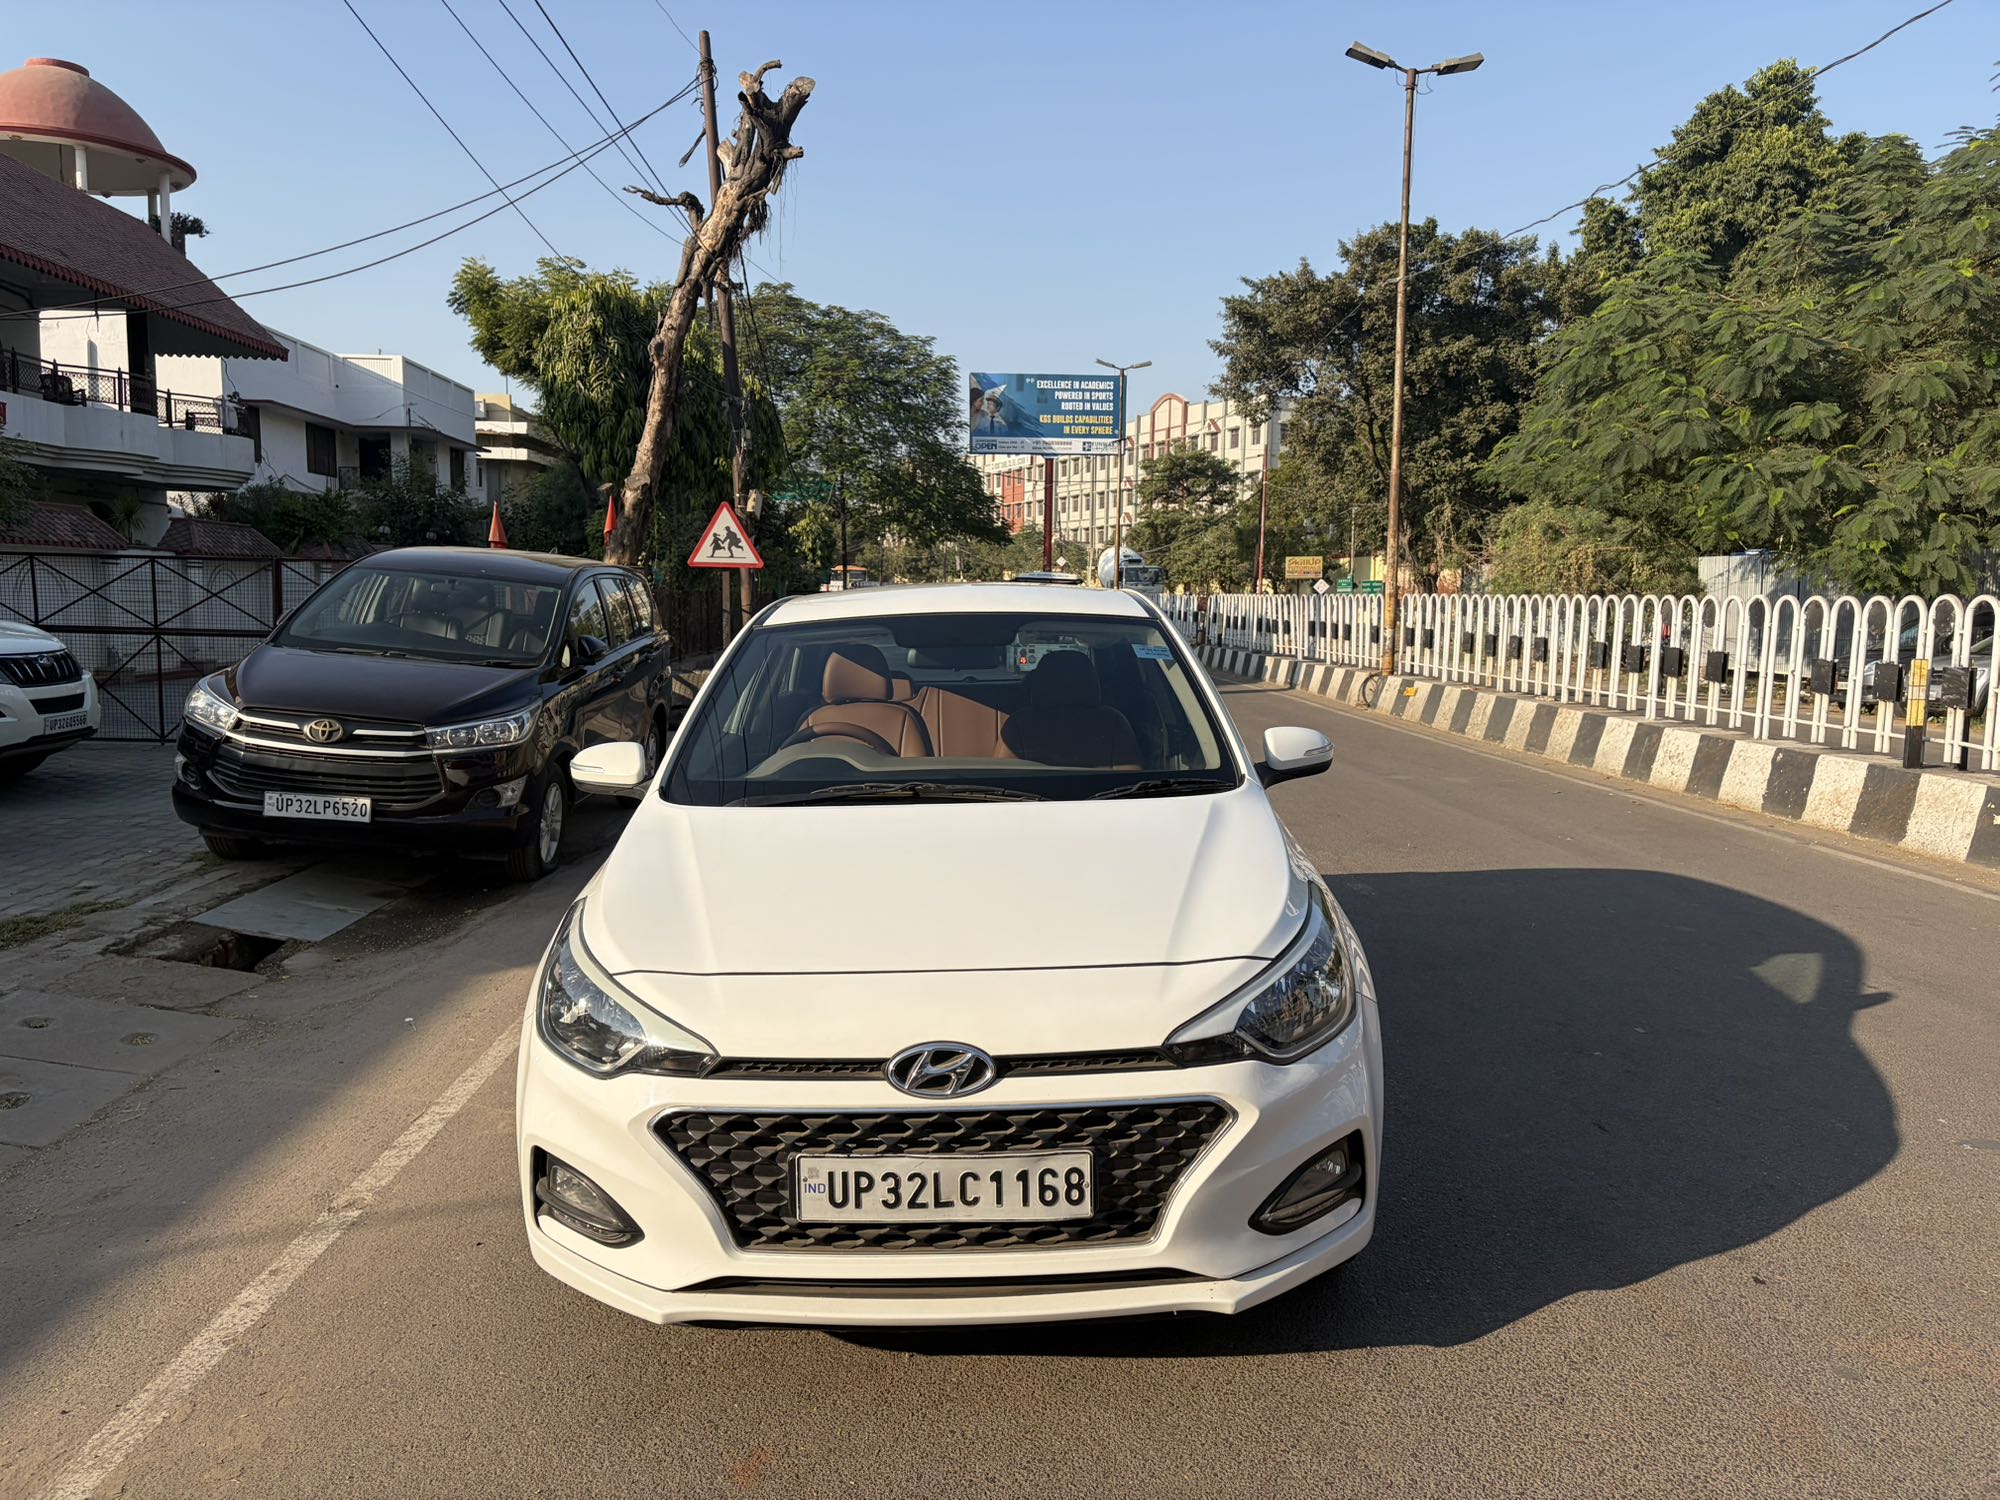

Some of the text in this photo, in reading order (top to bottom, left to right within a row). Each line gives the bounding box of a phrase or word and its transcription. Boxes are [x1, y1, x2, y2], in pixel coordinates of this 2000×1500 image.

[1036, 380, 1114, 390] EXCELLENCE IN ACADEMICS
[1054, 391, 1114, 401] POWERED IN SPORTS
[1061, 402, 1114, 411] ROOTED IN VALUES
[1053, 415, 1074, 424] BUILDS
[1074, 415, 1114, 424] CAPABILITIES
[1063, 425, 1114, 435] IN EVERY SPHERE
[276, 797, 368, 817] UP32LP6520
[804, 1167, 1085, 1209] IND UP32LC1168
